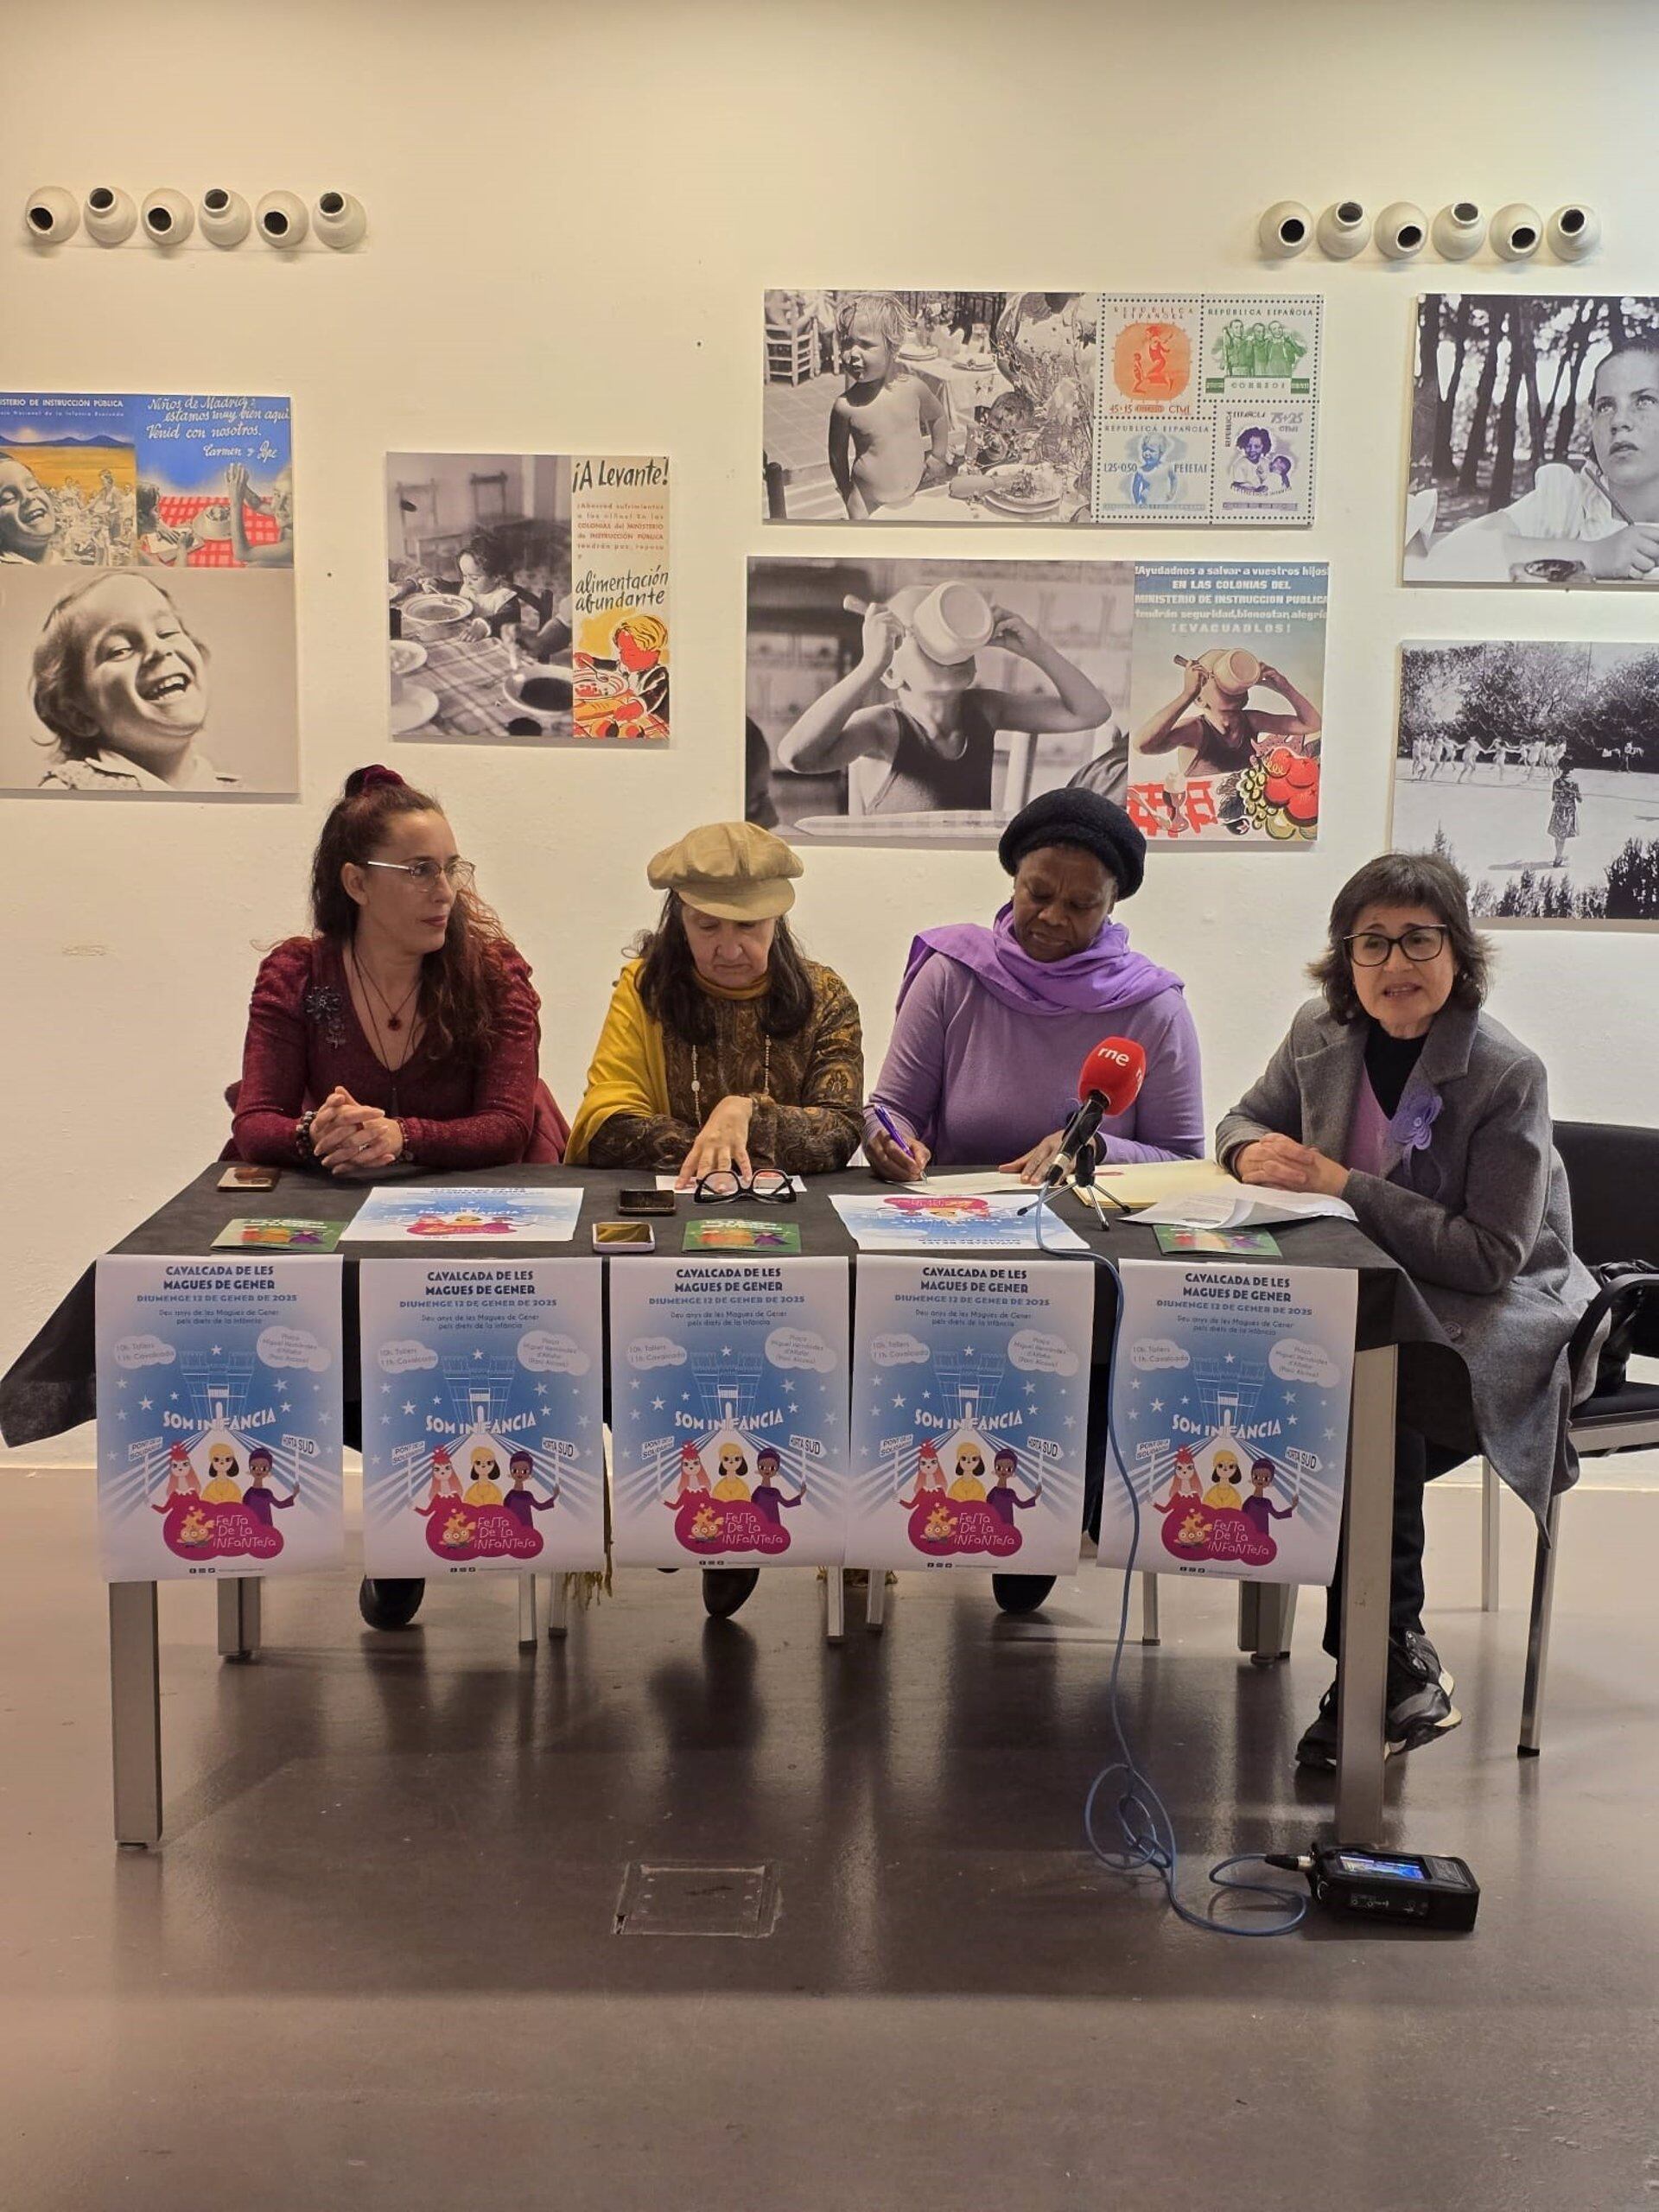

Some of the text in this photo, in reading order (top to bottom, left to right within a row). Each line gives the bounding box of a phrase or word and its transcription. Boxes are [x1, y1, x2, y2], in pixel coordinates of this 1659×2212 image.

[184, 396, 198, 410] de
[163, 410, 210, 423] estamos
[212, 410, 237, 423] muy
[238, 408, 261, 420] bien
[146, 423, 181, 439] Venid
[185, 429, 206, 438] con
[203, 443, 242, 457] Carmen
[598, 457, 669, 487] Levante!
[1206, 566, 1241, 575] salvar
[1252, 566, 1300, 576] vuestros
[575, 564, 669, 594] alimentación
[1172, 580, 1186, 588] EN
[1191, 580, 1211, 589] LAS
[1216, 580, 1268, 589] COLONIAS
[1135, 594, 1196, 604] MINISTERIO
[1198, 594, 1212, 604] DE
[1097, 1047, 1130, 1067] rne
[166, 1266, 273, 1275] CAVALCADA DE LES
[428, 1271, 533, 1281] CAVALCADA DE LES
[677, 1268, 781, 1278] CAVALCADA DE LES
[923, 1268, 1027, 1279] CAVALCADA DE LES
[163, 1280, 275, 1289] MAGUES DE GENER
[675, 1282, 783, 1292] MAGUES DE GENER
[1185, 1273, 1290, 1287] CAVALCADA DE LES
[426, 1285, 535, 1295] MAGUES DE GENER
[921, 1281, 1028, 1294] MAGUES DE GENER
[1183, 1287, 1291, 1302] MAGUES DE GENER
[895, 1294, 945, 1303] DIUMENGE
[1157, 1300, 1208, 1309] DIUMENGE
[162, 1410, 194, 1430] SOM
[426, 1414, 455, 1434] SOM
[675, 1410, 703, 1430] SOM
[914, 1408, 944, 1429] SOM
[1172, 1414, 1201, 1435] SOM
[297, 1439, 314, 1455] SUD
[557, 1442, 574, 1458] SUD
[804, 1440, 821, 1455] SUD
[1042, 1442, 1058, 1458] SUD
[1300, 1452, 1317, 1469] SUD
